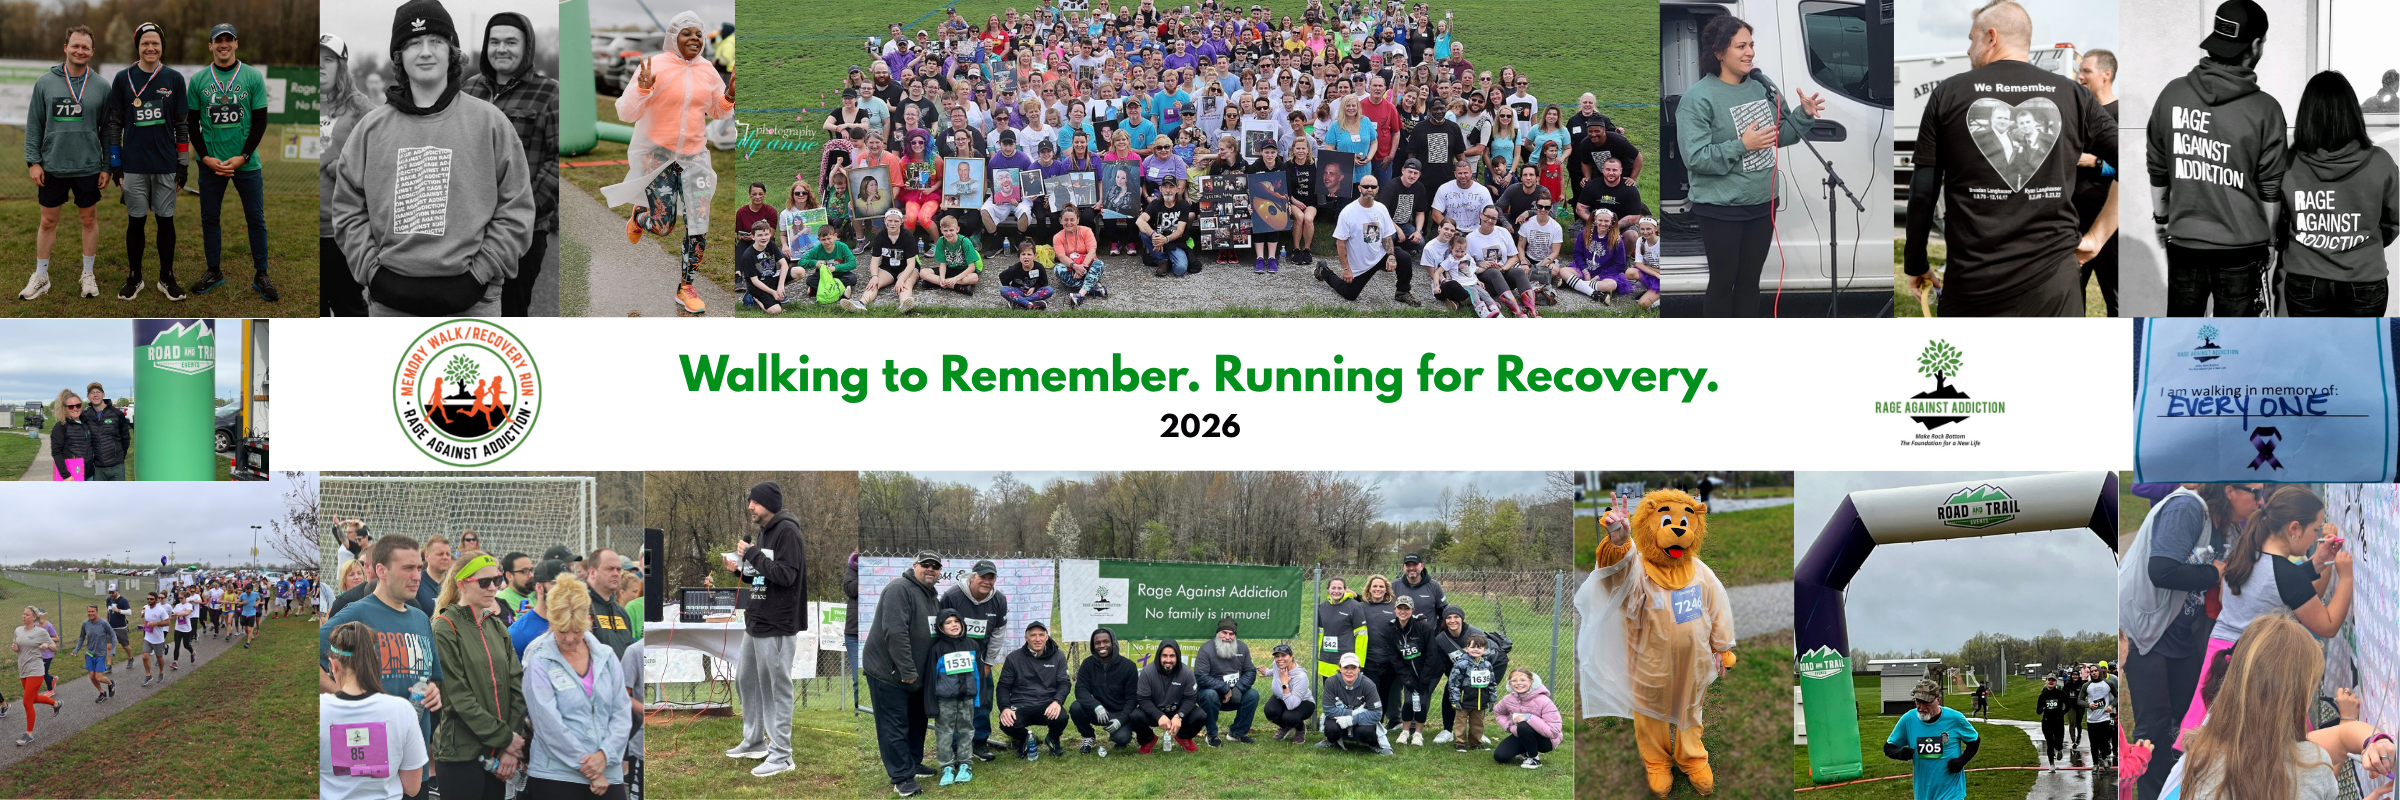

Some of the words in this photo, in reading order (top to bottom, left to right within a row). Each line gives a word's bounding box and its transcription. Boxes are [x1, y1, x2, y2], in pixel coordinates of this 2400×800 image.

[291, 82, 316, 96] Rage
[1914, 80, 1943, 99] ABI
[1974, 83, 1992, 92] We
[1996, 83, 2056, 92] Remember
[295, 100, 310, 110] No
[137, 107, 162, 121] 596
[213, 111, 238, 123] 730
[2172, 106, 2211, 134] RAGE
[2173, 132, 2231, 163] AGAINST
[2175, 158, 2244, 189] ADDICTION
[2295, 190, 2335, 211] RAGE
[2296, 212, 2361, 232] AGAINST
[2295, 232, 2370, 251] ADDICTIO
[148, 346, 180, 360] ROAD
[184, 347, 195, 357] AND
[2160, 387, 2164, 396] I
[2167, 388, 2187, 396] am
[2192, 385, 2241, 398] walking
[2245, 385, 2257, 395] in
[2262, 386, 2317, 398] memory
[2321, 385, 2338, 396] of:
[1938, 505, 1969, 519] ROAD
[1986, 500, 2020, 515] TRAIL
[1138, 583, 1173, 600] Rage
[1177, 584, 1225, 599] Against
[1230, 585, 1288, 598] Addiction
[1675, 596, 1702, 614] 7246
[1145, 608, 1164, 619] No
[1168, 608, 1204, 622] family
[1208, 608, 1216, 619] is
[1221, 608, 1270, 619] immune!
[946, 657, 972, 668] 1531
[1824, 659, 1844, 669] TRAIL
[350, 747, 365, 760] 85
[1918, 743, 1942, 753] 705
